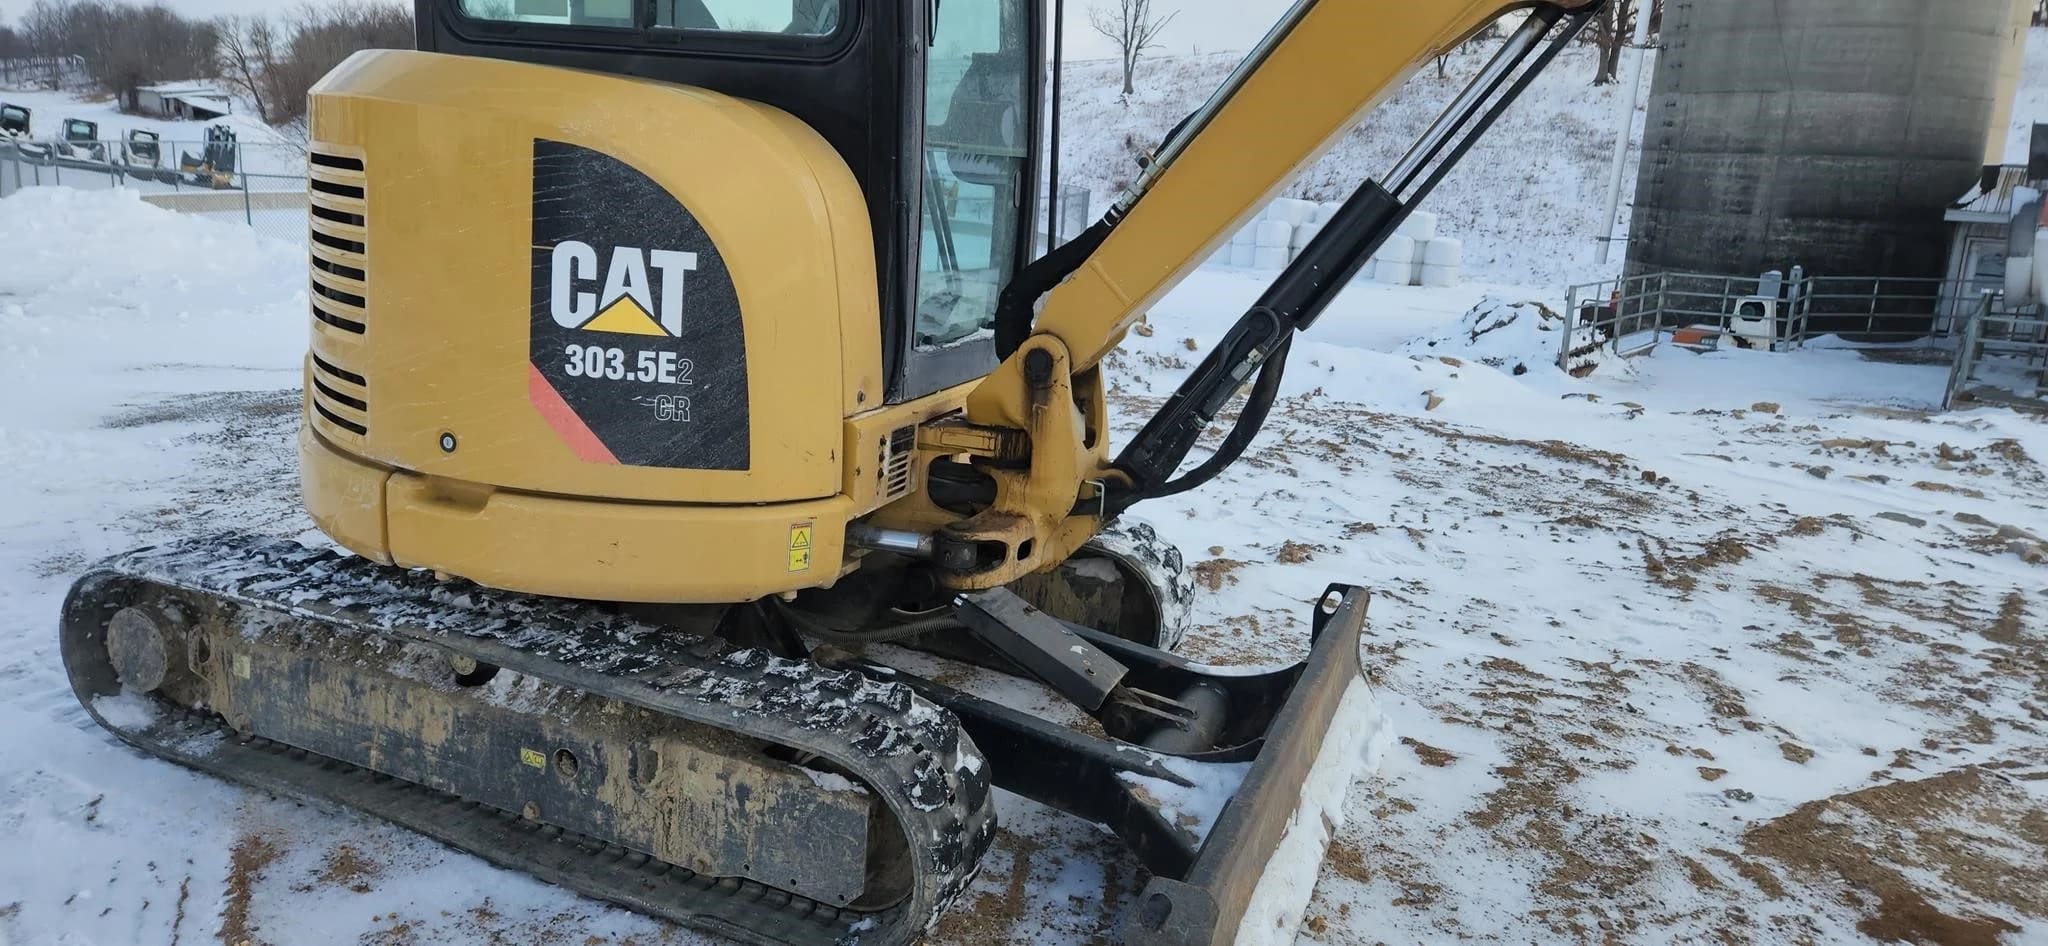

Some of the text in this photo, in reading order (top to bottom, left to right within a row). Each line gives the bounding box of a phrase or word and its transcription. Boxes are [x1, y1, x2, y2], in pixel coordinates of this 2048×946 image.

[551, 240, 697, 337] CAT
[565, 344, 694, 385] 303.5E2
[654, 394, 691, 422] CR
